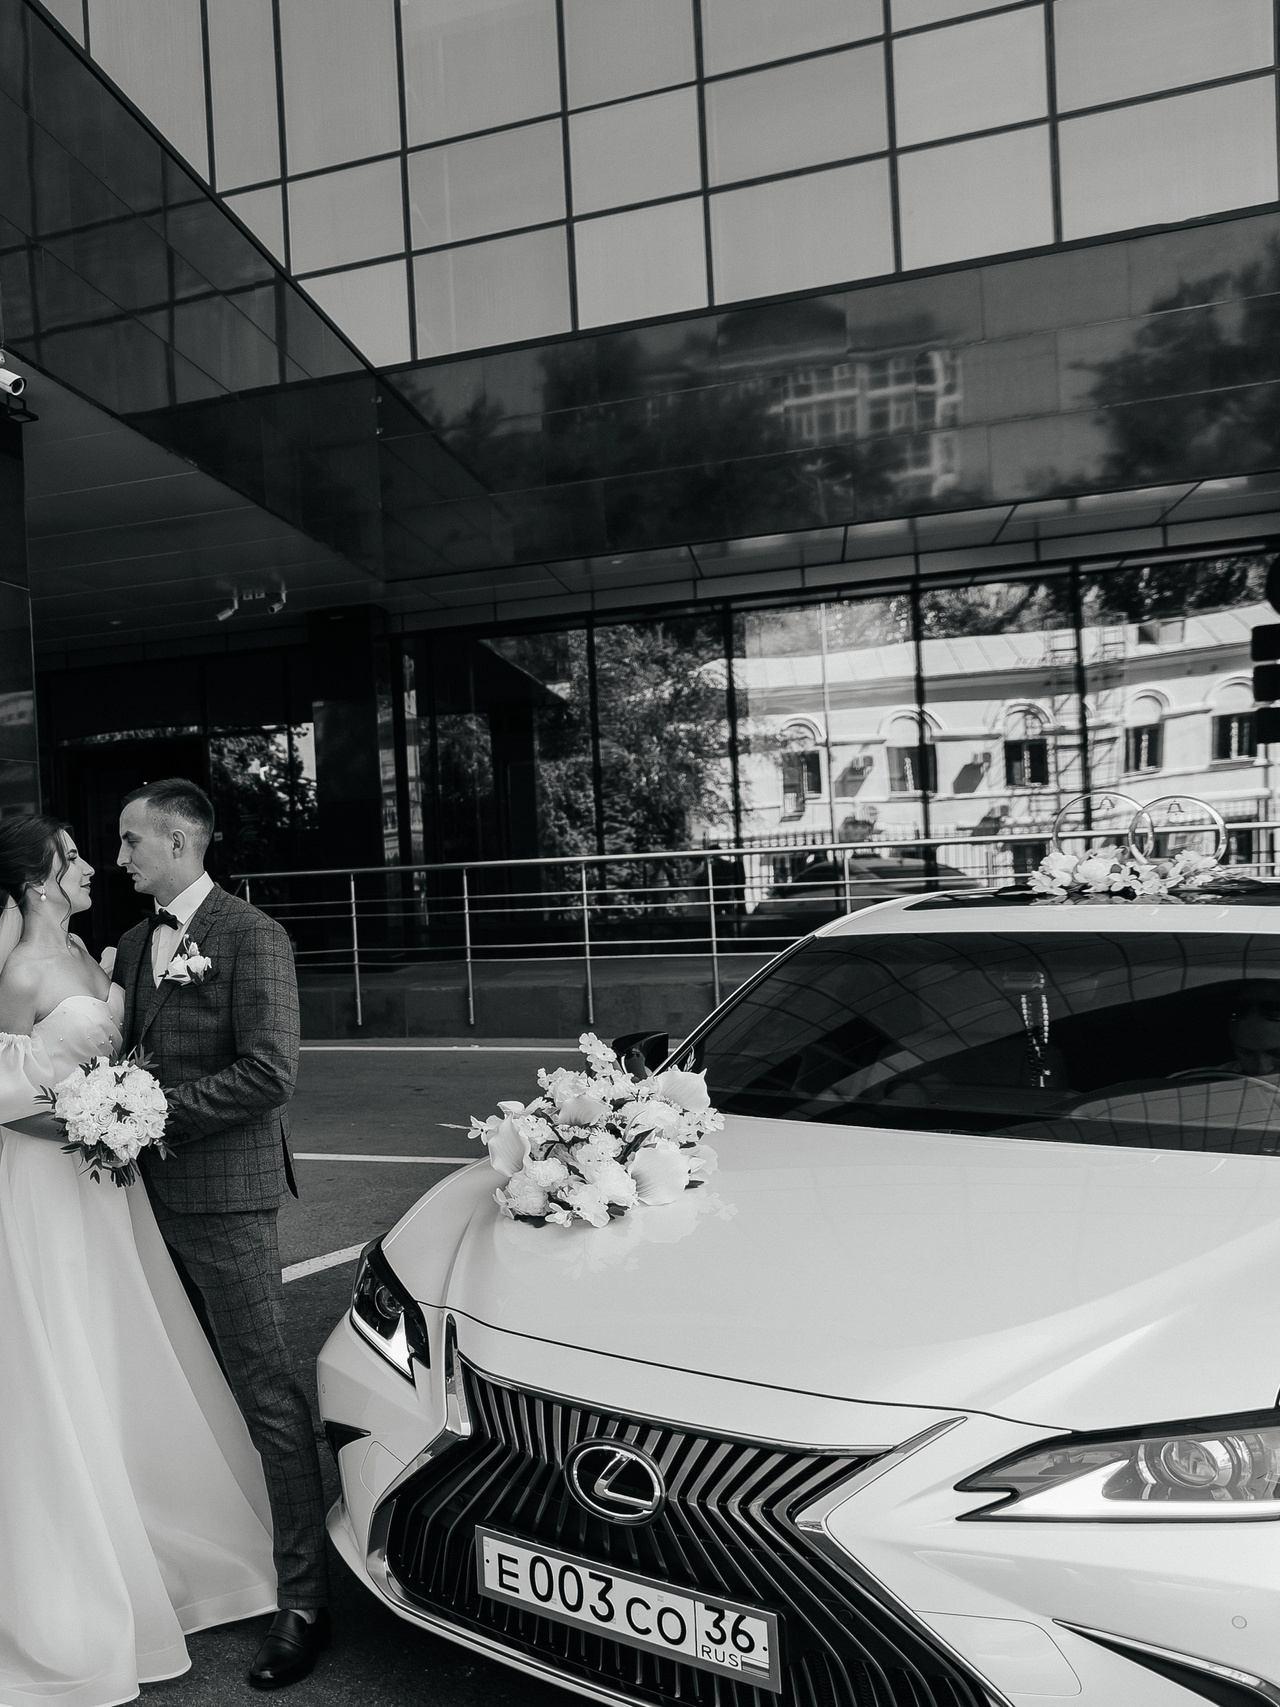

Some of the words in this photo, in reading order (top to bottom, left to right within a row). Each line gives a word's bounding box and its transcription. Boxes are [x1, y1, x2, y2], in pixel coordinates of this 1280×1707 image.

[497, 1552, 688, 1646] E003CO
[703, 1602, 756, 1654] 36
[701, 1644, 739, 1668] RUS
